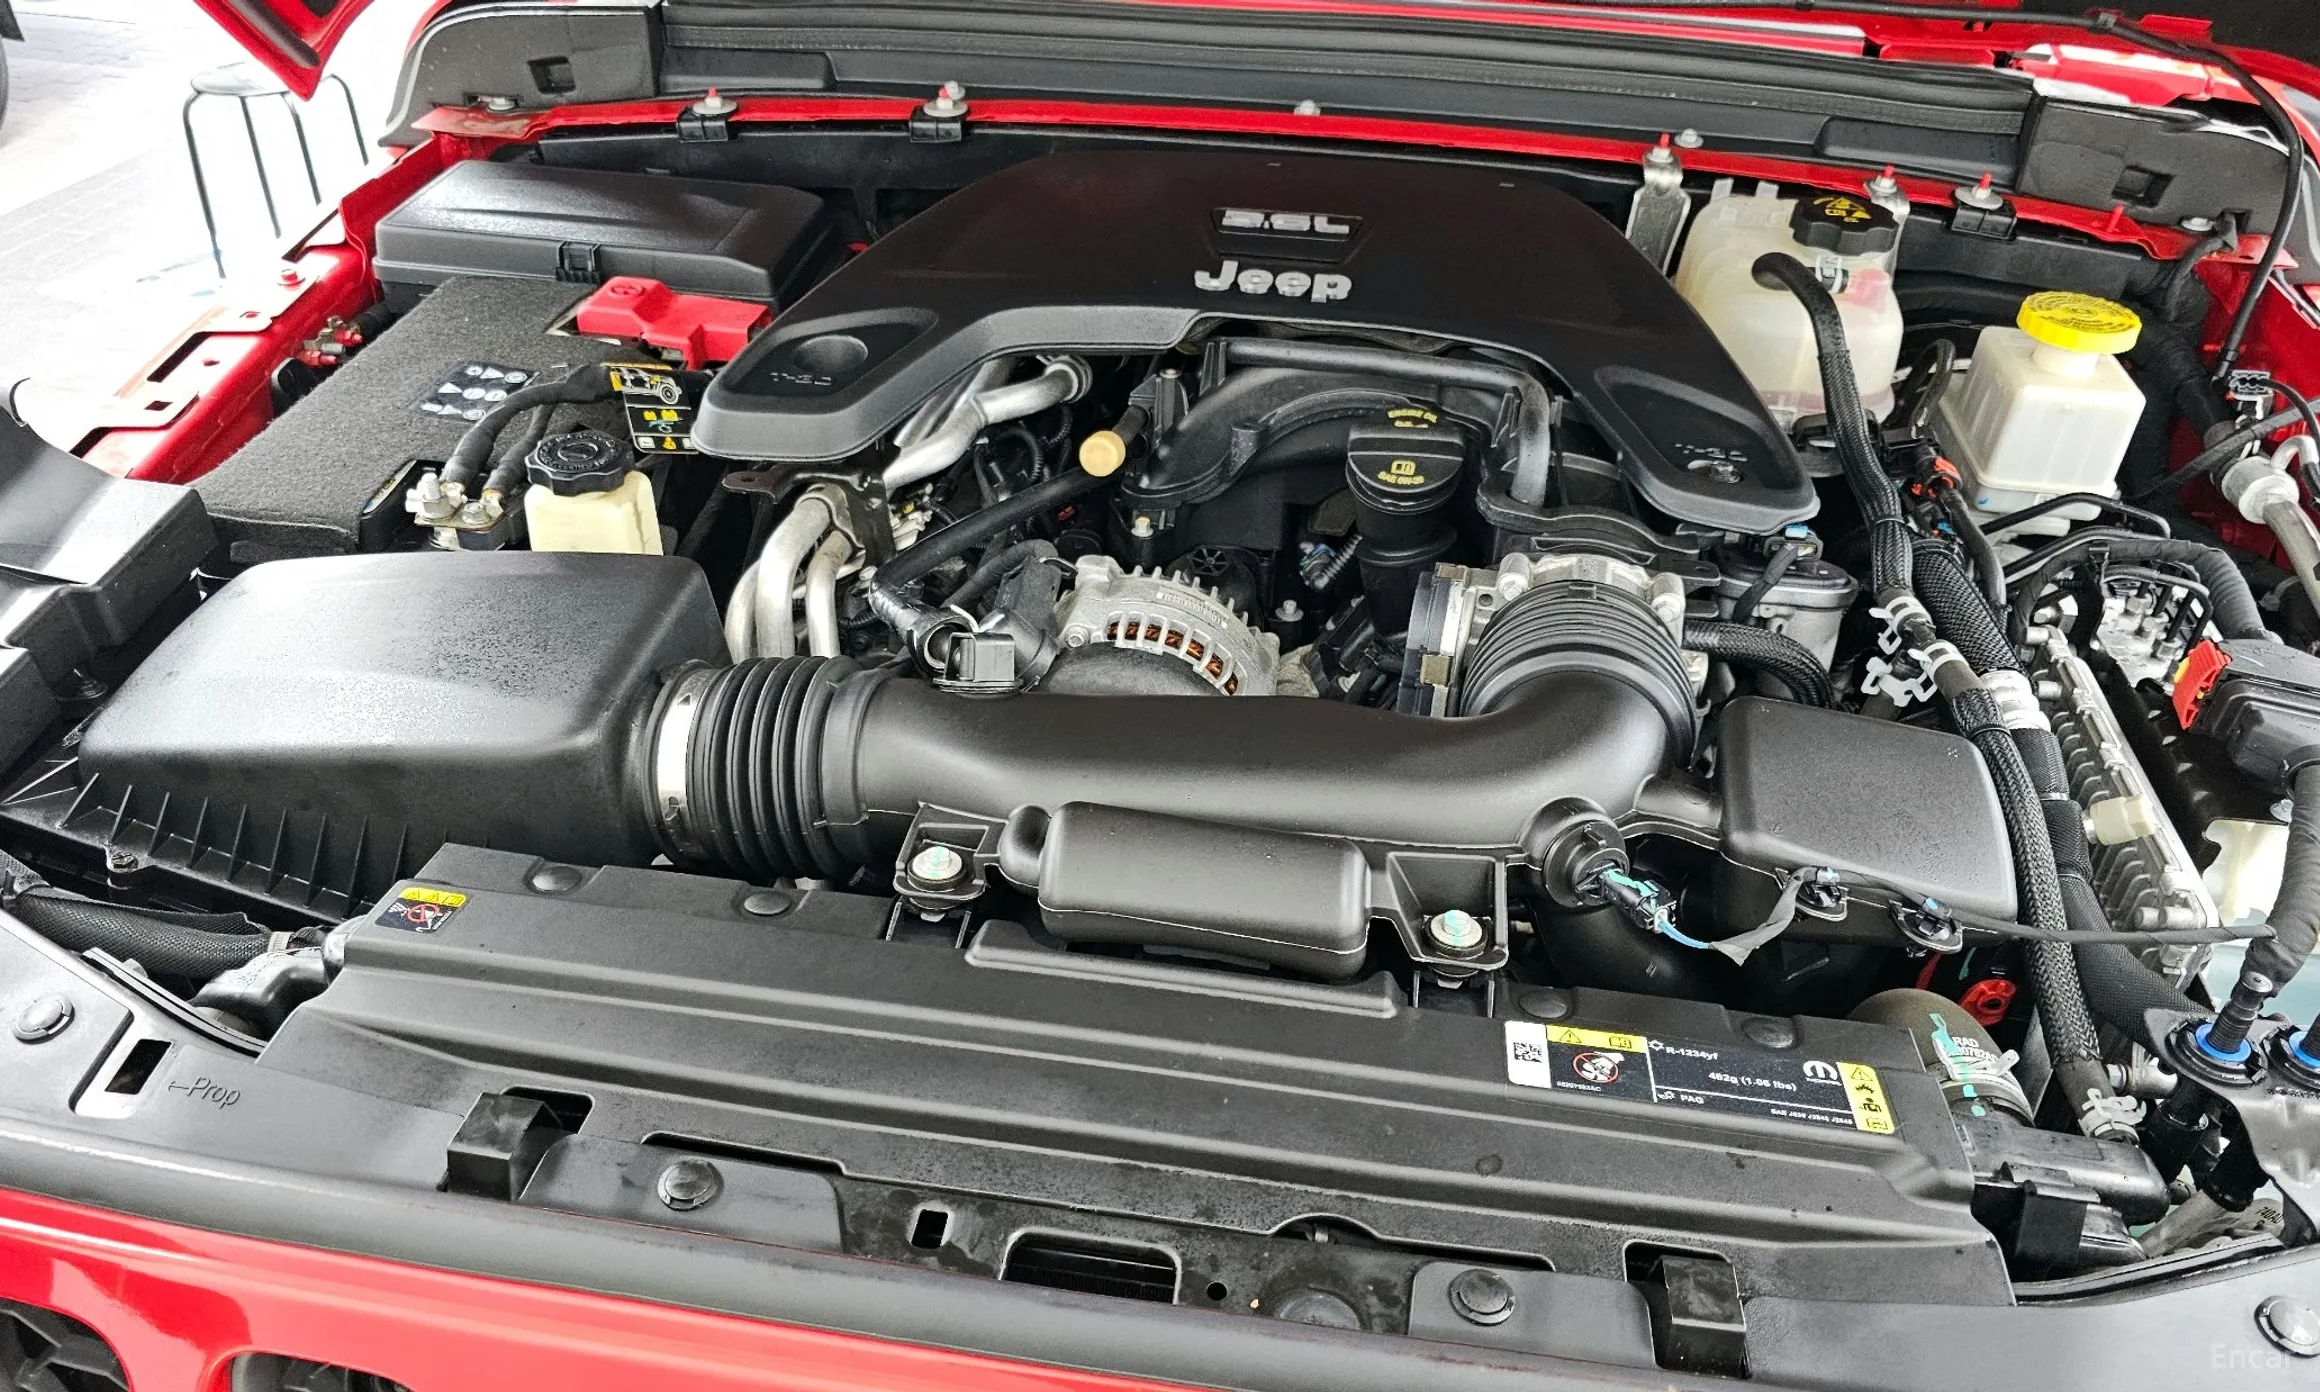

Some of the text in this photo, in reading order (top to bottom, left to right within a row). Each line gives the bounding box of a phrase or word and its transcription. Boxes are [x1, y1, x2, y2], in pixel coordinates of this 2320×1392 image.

[1194, 260, 1353, 303] Jeep
[1952, 1036, 1979, 1048] RAD
[1666, 1046, 1719, 1061] R-1234yf
[1772, 1080, 1797, 1092] lbs)
[187, 1076, 241, 1110] Prop
[1680, 1095, 1704, 1105] PAG
